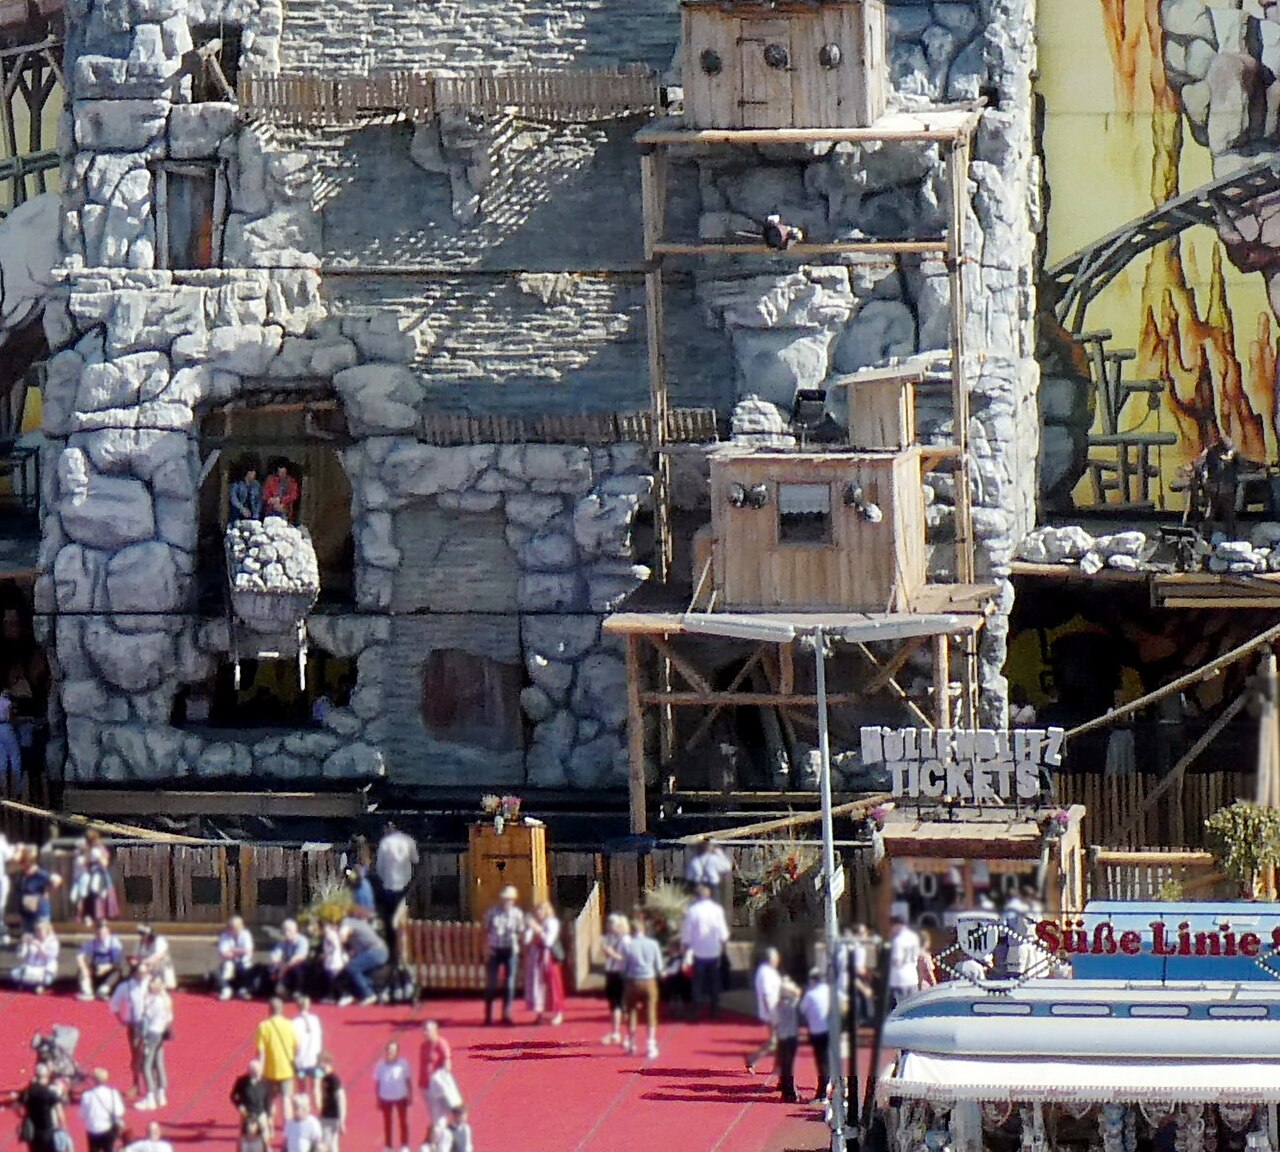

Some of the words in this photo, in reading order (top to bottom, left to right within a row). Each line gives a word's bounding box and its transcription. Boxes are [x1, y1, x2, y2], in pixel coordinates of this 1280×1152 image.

[860, 726, 1065, 765] HÖLLENBLITZ
[886, 759, 1041, 799] TICKETS
[1035, 919, 1142, 954] Süße
[1149, 920, 1261, 956] Linie
